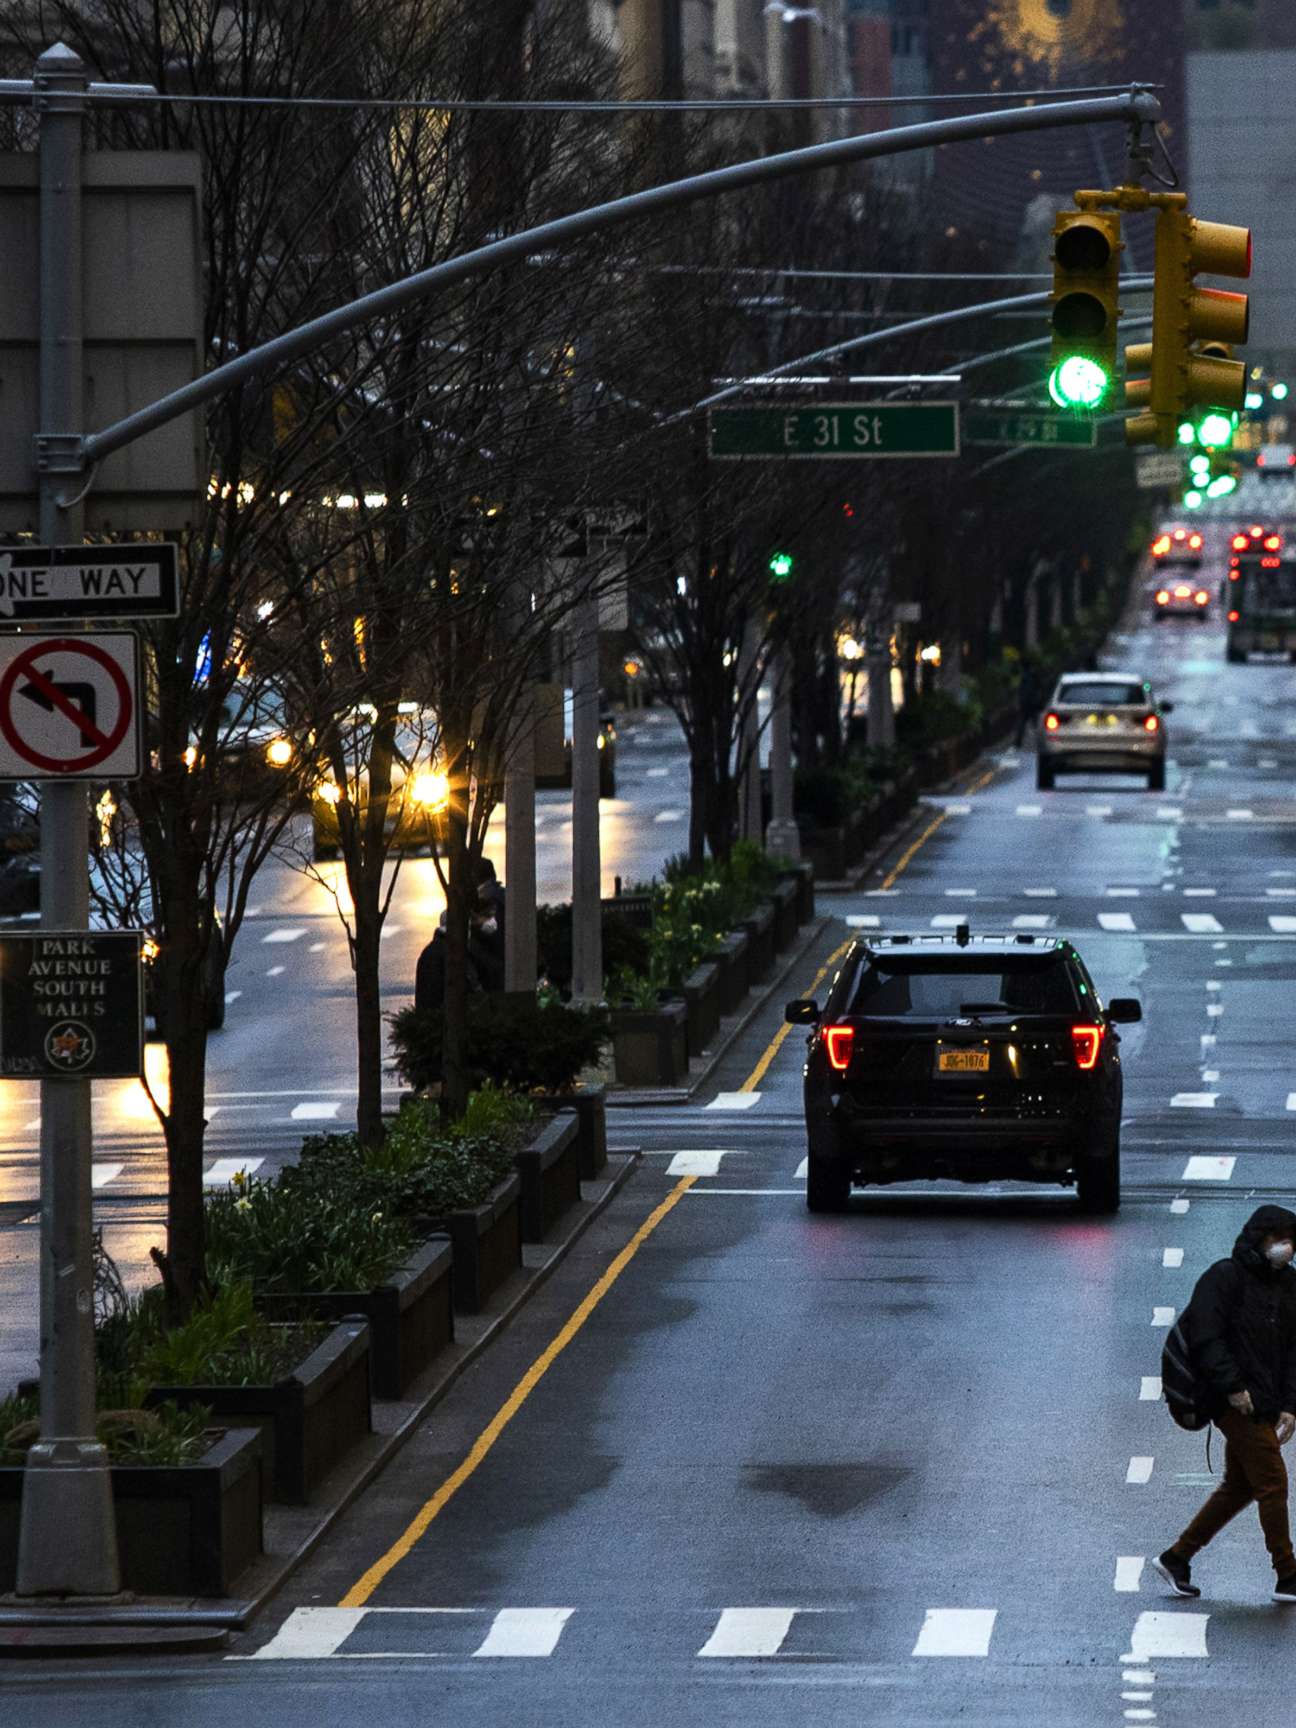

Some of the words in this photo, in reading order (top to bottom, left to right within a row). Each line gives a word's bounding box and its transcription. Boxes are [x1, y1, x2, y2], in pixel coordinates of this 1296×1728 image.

[783, 415, 800, 446] E
[813, 415, 840, 446] 31
[852, 414, 883, 446] St
[0, 571, 48, 598] NE
[80, 568, 146, 596] WAY
[42, 940, 96, 955] PARK
[28, 960, 112, 976] AVENUE
[32, 980, 106, 996] SOUTH
